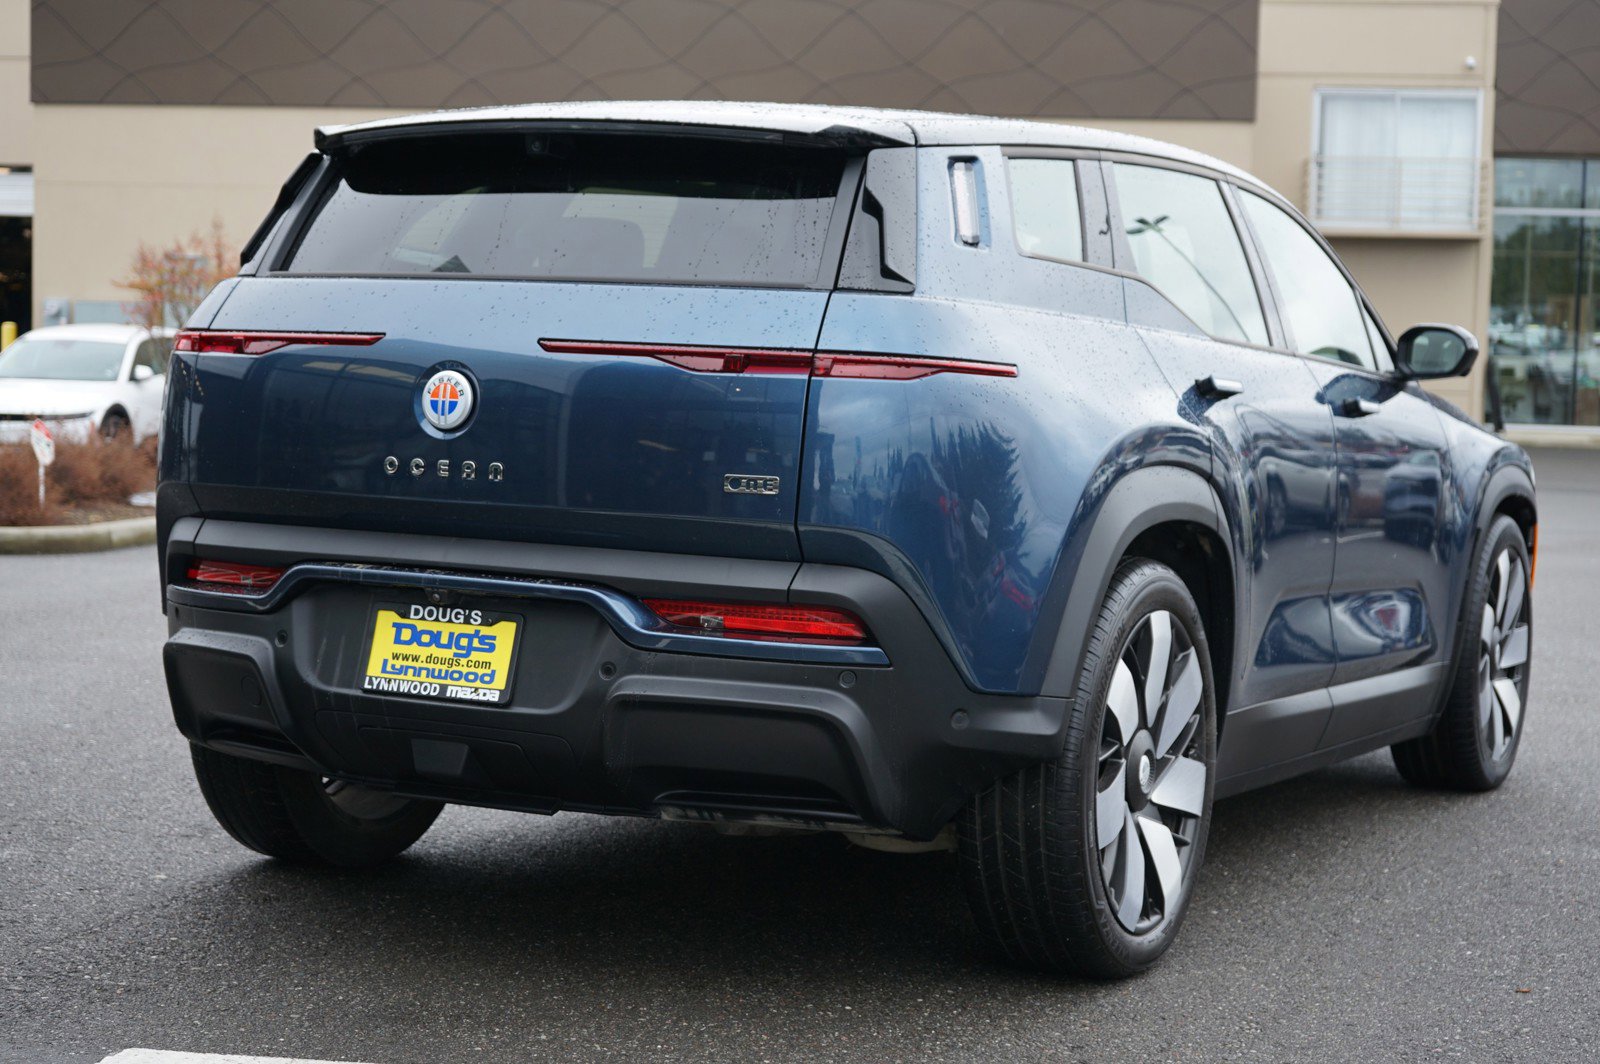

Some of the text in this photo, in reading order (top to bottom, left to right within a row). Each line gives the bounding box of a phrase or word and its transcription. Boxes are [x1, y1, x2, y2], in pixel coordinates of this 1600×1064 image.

[427, 377, 465, 397] FISKER
[384, 456, 504, 482] OCEAN
[409, 604, 482, 625] DOUG'S
[391, 652, 492, 670] www.dougs.com
[380, 658, 496, 685] Lynnwood
[363, 676, 440, 696] LYNNWOOD
